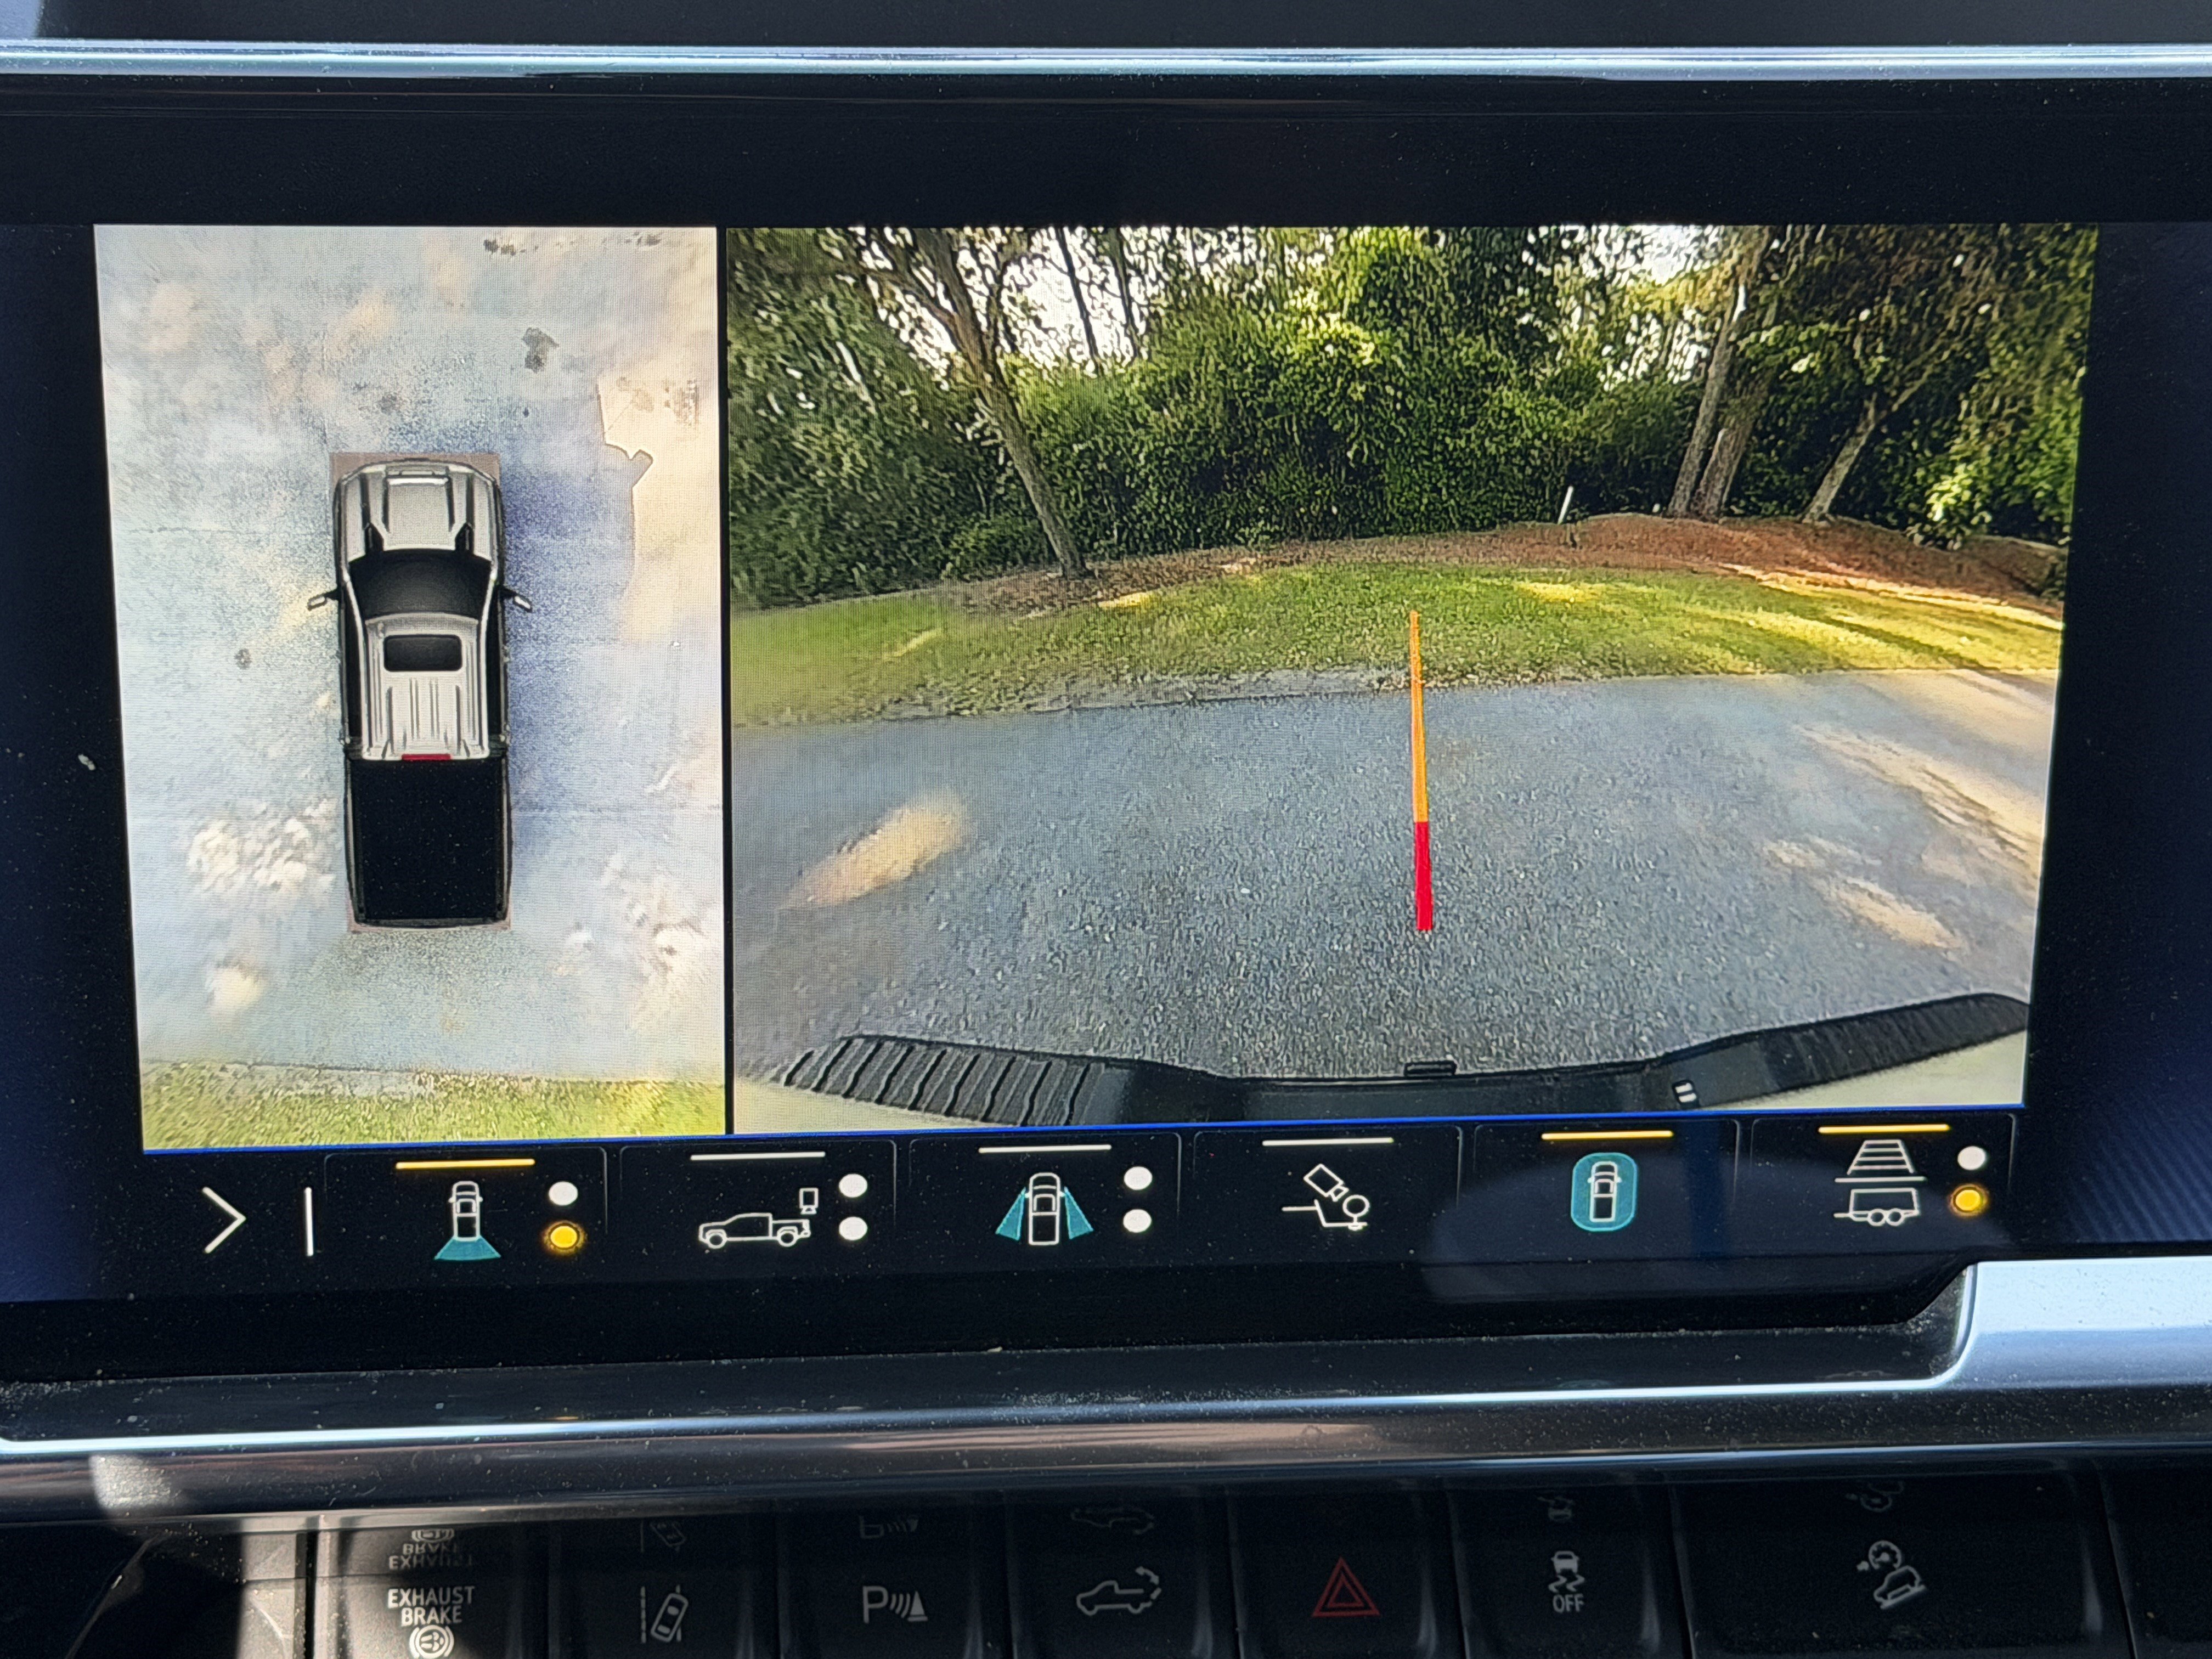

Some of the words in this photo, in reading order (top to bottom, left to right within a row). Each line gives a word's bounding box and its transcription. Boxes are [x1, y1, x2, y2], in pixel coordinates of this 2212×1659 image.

[388, 1586, 475, 1609] EXHAUST
[863, 1585, 888, 1623] P
[1553, 1594, 1584, 1613] OFF
[401, 1606, 462, 1627] BRAKE
